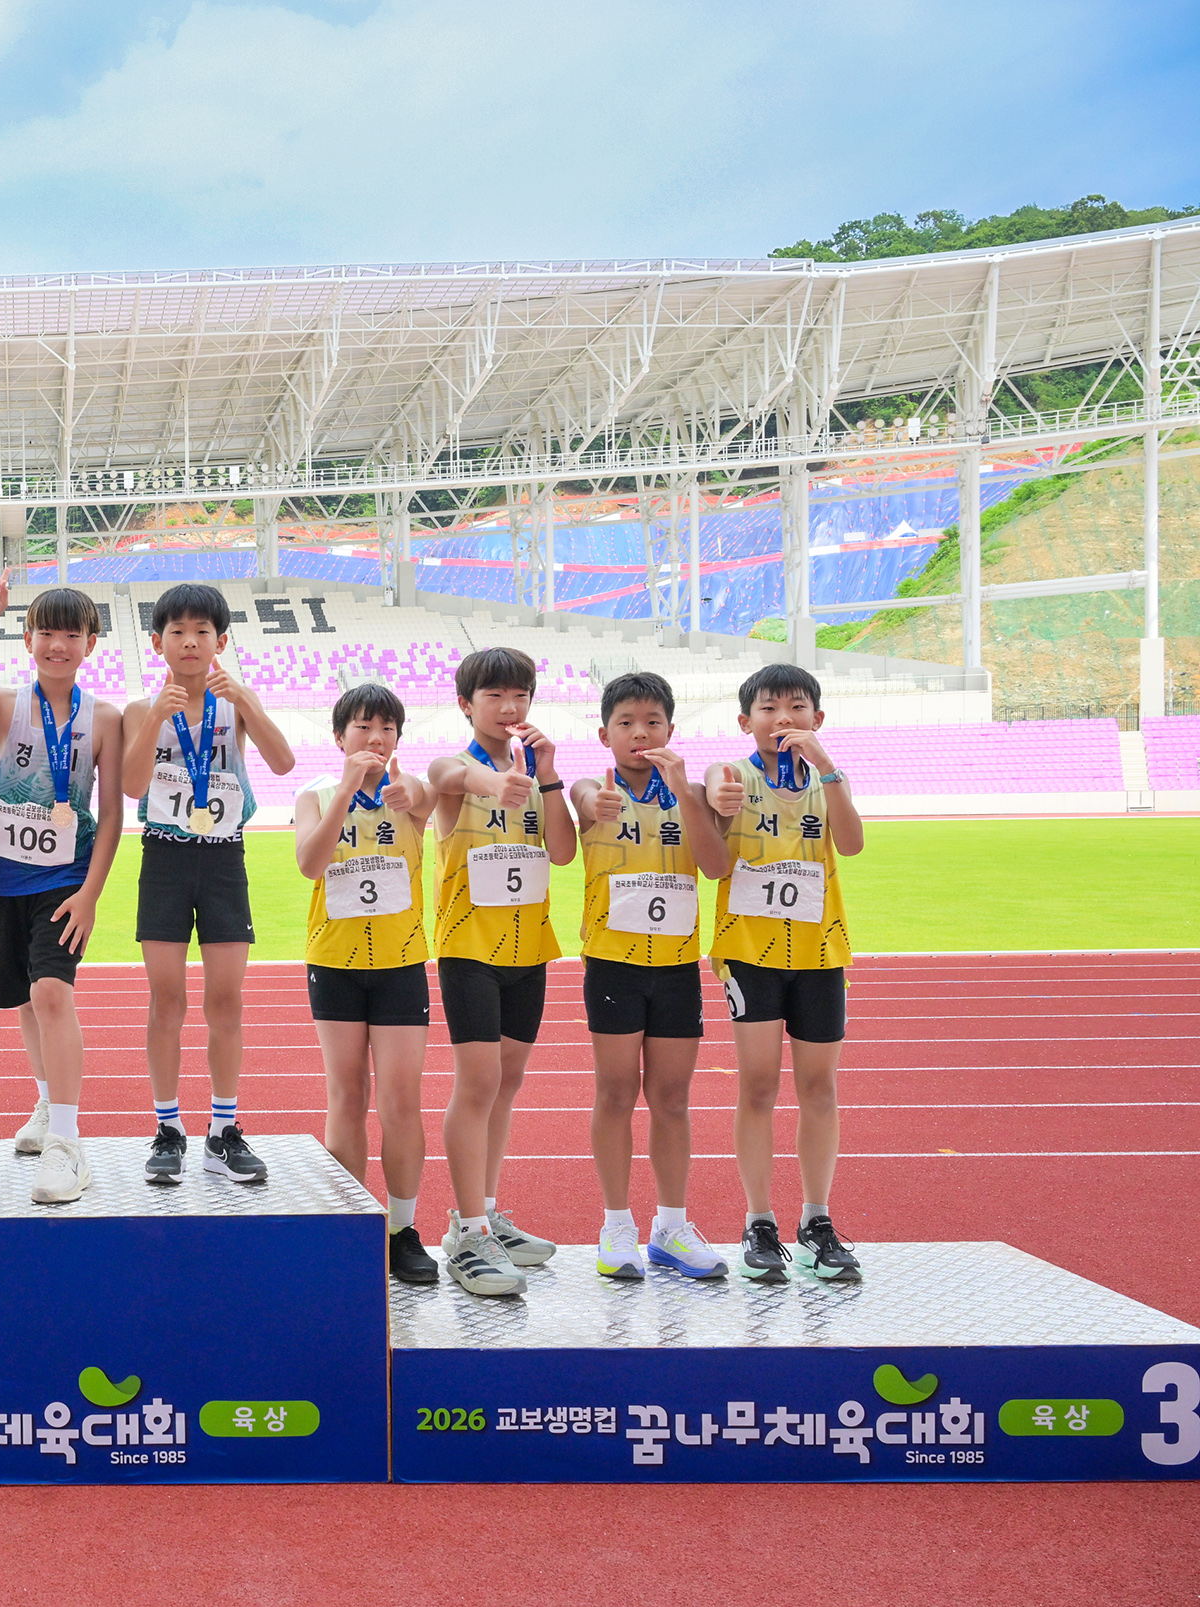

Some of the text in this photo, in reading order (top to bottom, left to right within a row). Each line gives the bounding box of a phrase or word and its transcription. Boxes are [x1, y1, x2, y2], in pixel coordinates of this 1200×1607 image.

[337, 820, 395, 848] 서울
[486, 809, 539, 835] 서울
[616, 821, 682, 846] 서울
[755, 814, 823, 839] 서울
[4, 824, 57, 854] 106
[345, 856, 359, 867] 2026
[360, 880, 378, 904] 3
[506, 867, 522, 893] 5
[762, 881, 799, 907] 10
[648, 897, 666, 922] 6
[1141, 1362, 1200, 1465] 3
[416, 1397, 985, 1465] 2026 교보생명컵 꿈나무체육대회
[110, 1451, 186, 1464] Since 1985
[905, 1451, 985, 1464] Since 1985
